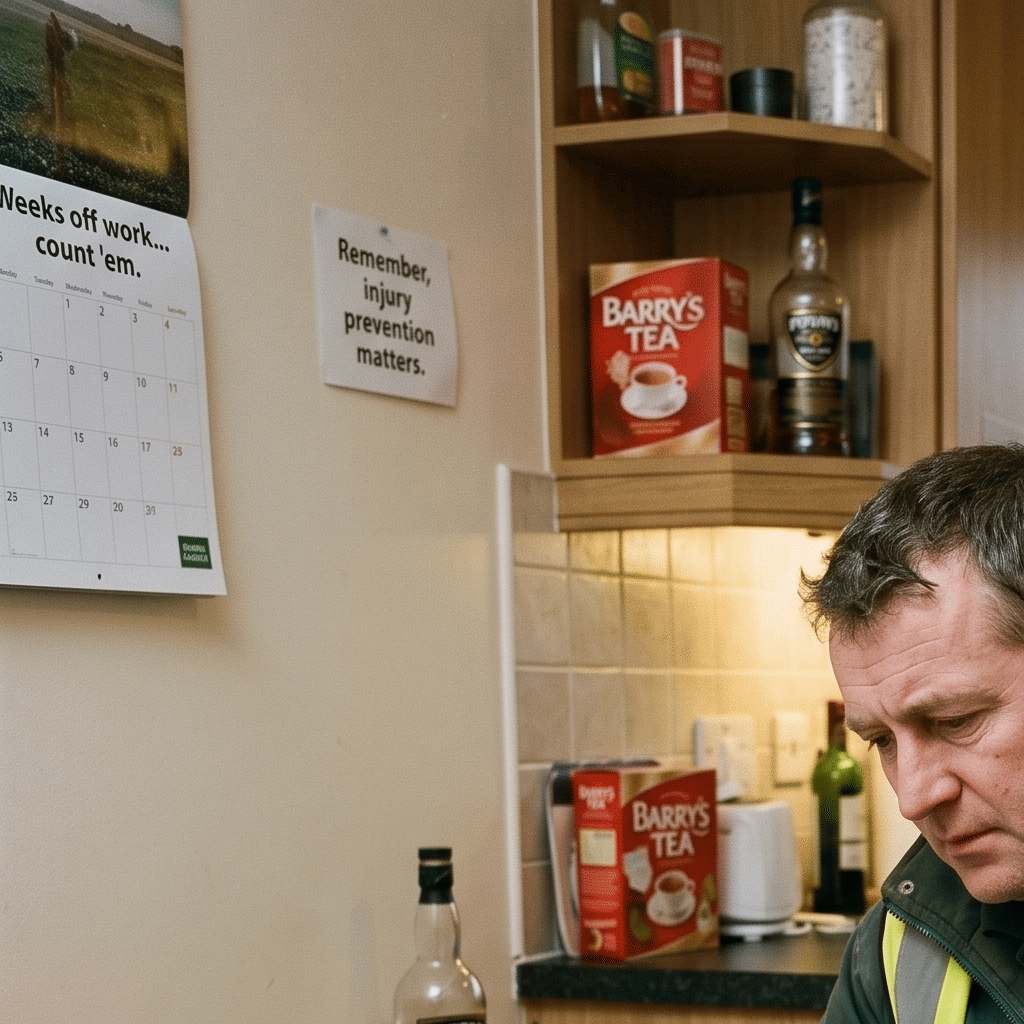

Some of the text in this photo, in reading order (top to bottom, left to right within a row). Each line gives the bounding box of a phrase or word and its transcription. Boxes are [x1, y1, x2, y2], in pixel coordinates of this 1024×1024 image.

[70, 206, 98, 233] off
[103, 218, 170, 252] work...
[35, 236, 141, 278] count 'em.
[338, 237, 431, 287] Remember,
[66, 298, 170, 330] 1 2 3 4
[363, 277, 412, 316] injury
[602, 291, 705, 331] BARRY'S
[344, 311, 435, 347] prevention
[624, 323, 680, 354] TEA
[33, 357, 178, 394] 7 8 9 10 11
[357, 346, 425, 376] matters.
[2, 421, 13, 433] 13
[38, 426, 50, 438] 14
[74, 431, 84, 443] 15
[108, 436, 119, 448] 16
[141, 441, 151, 452] 17
[43, 494, 54, 506] 27
[78, 498, 90, 509] 29
[631, 796, 711, 838] BARRY'S
[650, 830, 696, 858] TEA
